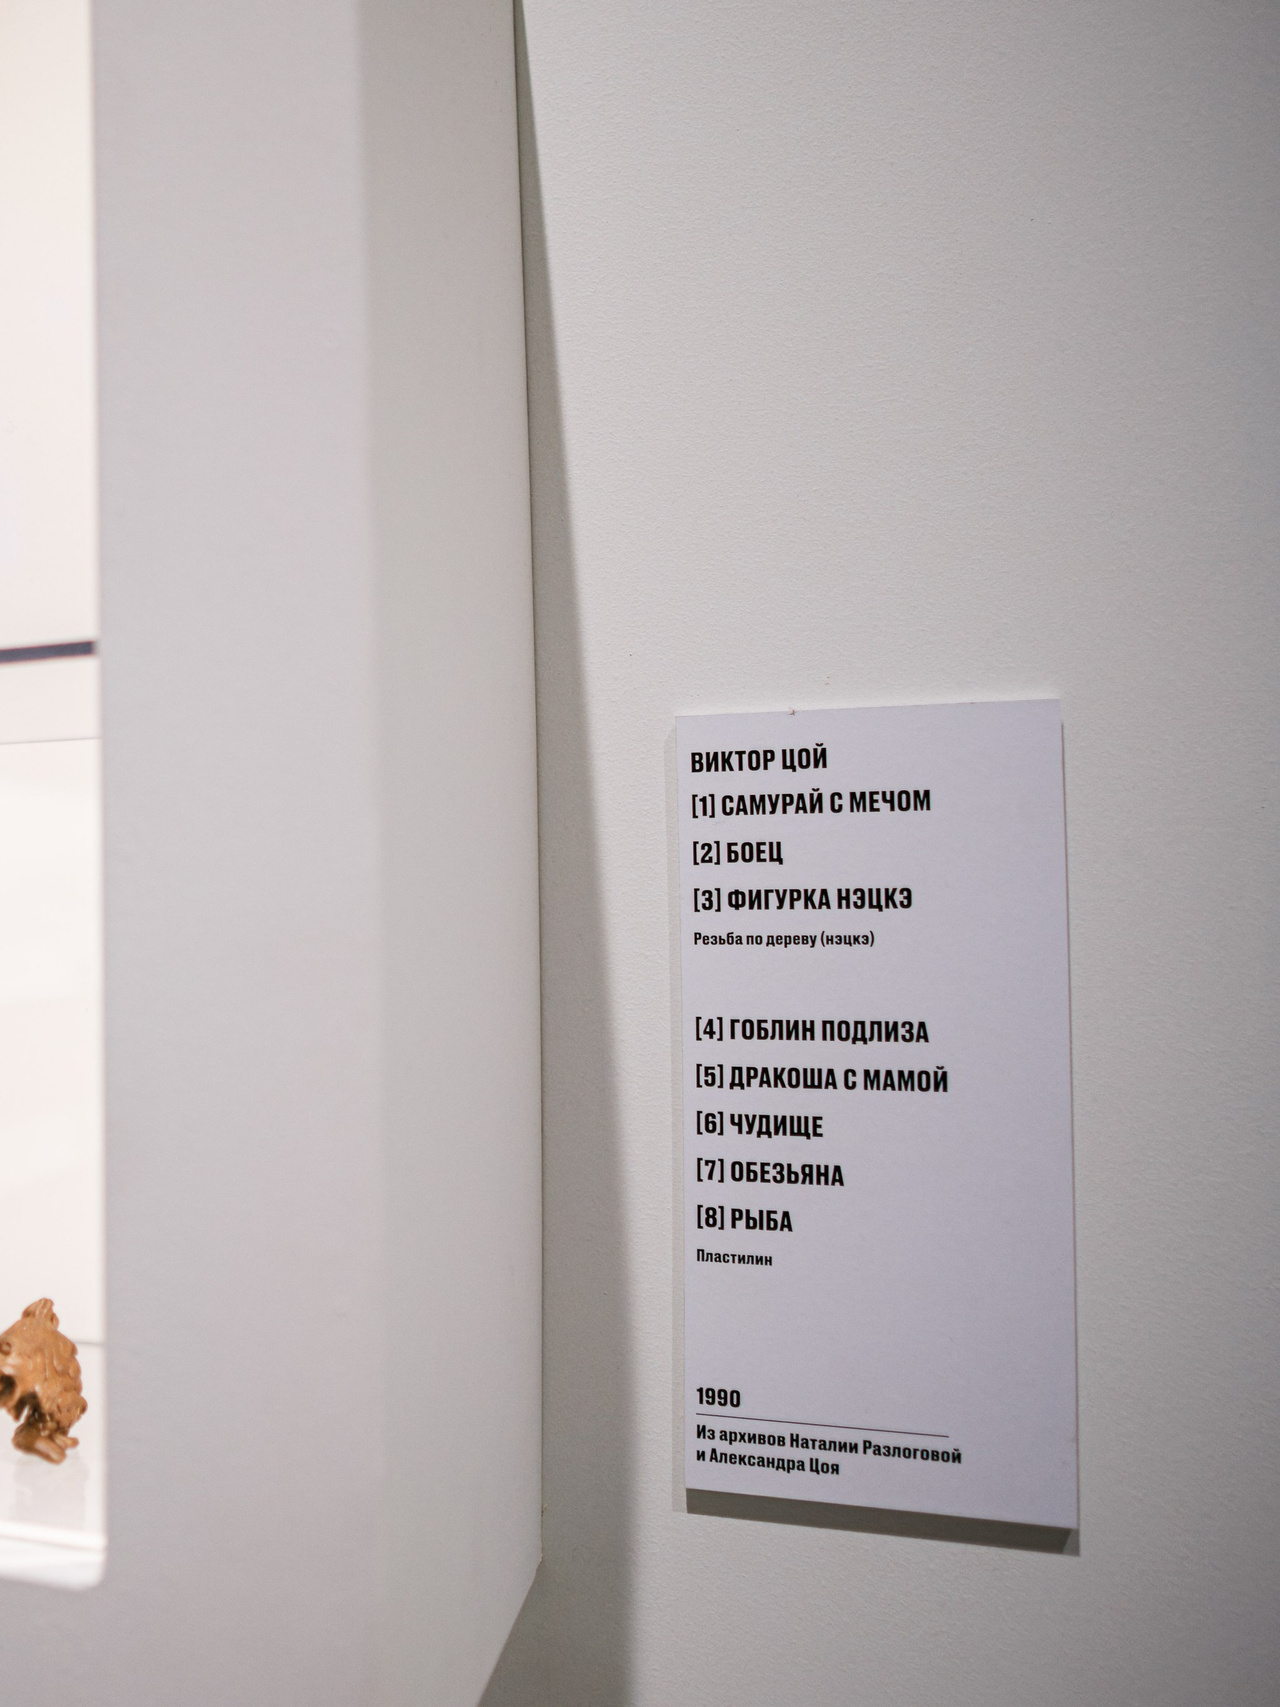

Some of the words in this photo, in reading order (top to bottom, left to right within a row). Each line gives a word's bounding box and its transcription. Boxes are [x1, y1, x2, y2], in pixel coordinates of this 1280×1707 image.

[691, 750, 775, 772] ВИКТОР
[782, 743, 827, 772] ЦОЙ
[692, 794, 715, 818] [1]
[722, 788, 823, 816] САМУРАЙ
[830, 792, 843, 813] С
[850, 790, 930, 812] МЕЧОМ
[693, 841, 720, 865] [2]
[727, 842, 783, 865] БОЕЦ
[694, 888, 721, 912] [3]
[728, 889, 831, 910] ФИГУРКА
[837, 888, 912, 912] НЭЦКЭ
[694, 932, 743, 945] Резьба
[746, 935, 762, 945] по
[766, 935, 817, 948] дереву
[821, 931, 874, 947] (нэцкэ)
[696, 1017, 723, 1041] [4]
[730, 1019, 815, 1041] ГОБЛИН
[822, 1020, 929, 1045] ПОДЛИЗА
[696, 1064, 723, 1088] [5]
[729, 1066, 837, 1090] ДРАКОША
[844, 1069, 856, 1090] С
[864, 1066, 948, 1092] МАМОЙ
[697, 1111, 723, 1136] [6]
[730, 1114, 823, 1140] ЧУДИЩЕ
[697, 1158, 724, 1183] [7]
[731, 1161, 844, 1186] ОБЕЗЬЯНА
[697, 1205, 724, 1230] [8]
[731, 1208, 793, 1232] РЫБА
[697, 1249, 772, 1266] Пластилин
[697, 1387, 740, 1408] 1990
[697, 1424, 715, 1440] Из
[719, 1430, 785, 1447] архивов
[790, 1433, 858, 1454] Наталии
[863, 1440, 962, 1464] Разлоговой
[697, 1450, 705, 1461] и
[710, 1450, 805, 1473] Александра
[810, 1458, 839, 1475] Цоя
